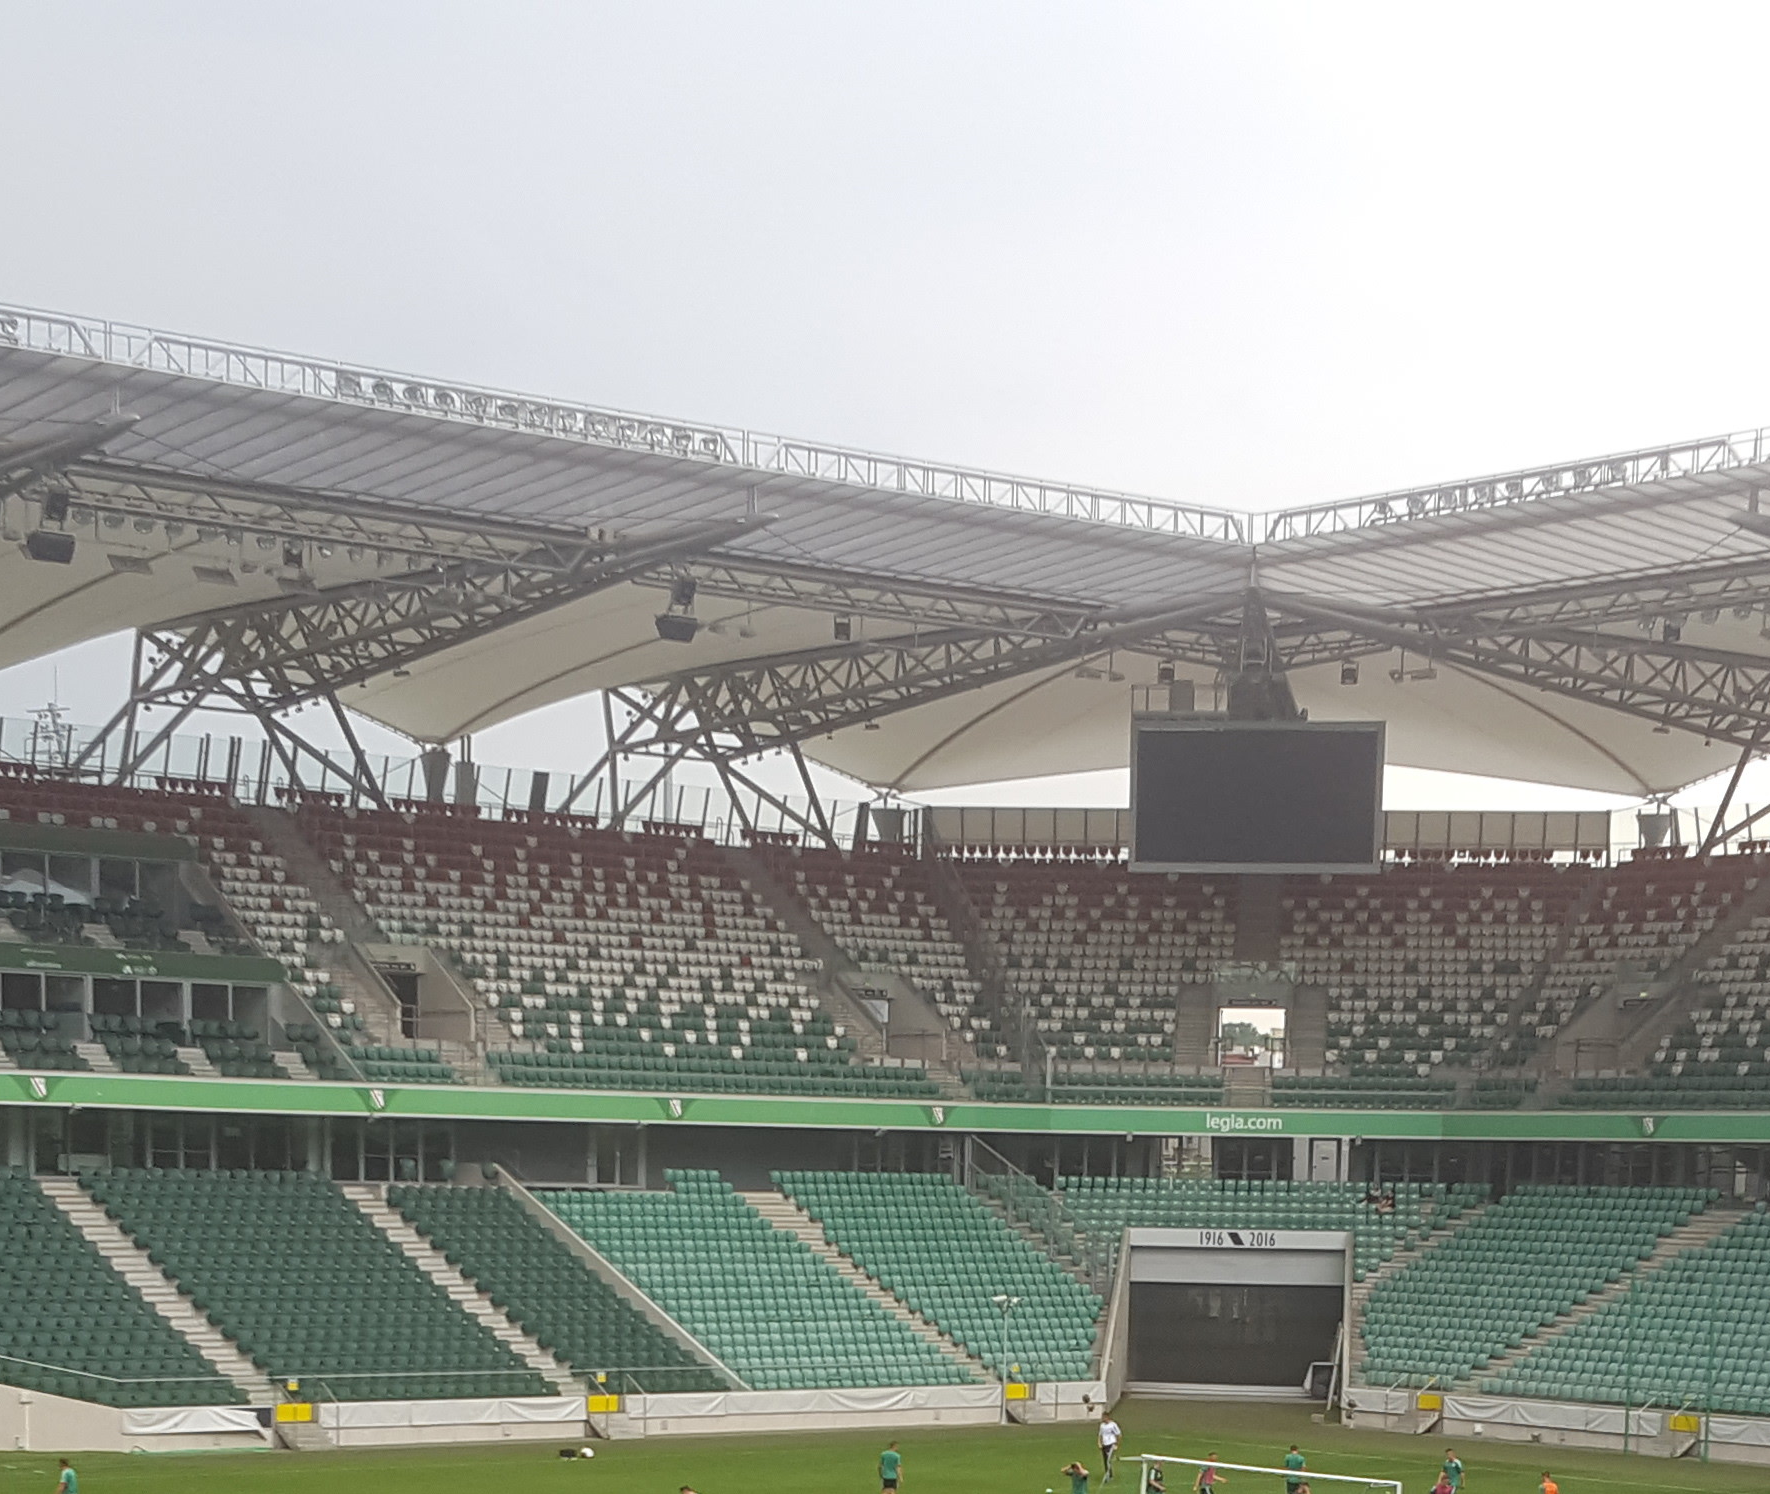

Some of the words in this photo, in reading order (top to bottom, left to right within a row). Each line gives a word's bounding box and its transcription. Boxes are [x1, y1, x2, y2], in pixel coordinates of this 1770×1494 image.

[1206, 1112, 1283, 1133] legia.com
[1199, 1231, 1224, 1246] 1916
[1249, 1232, 1276, 1247] 2016
